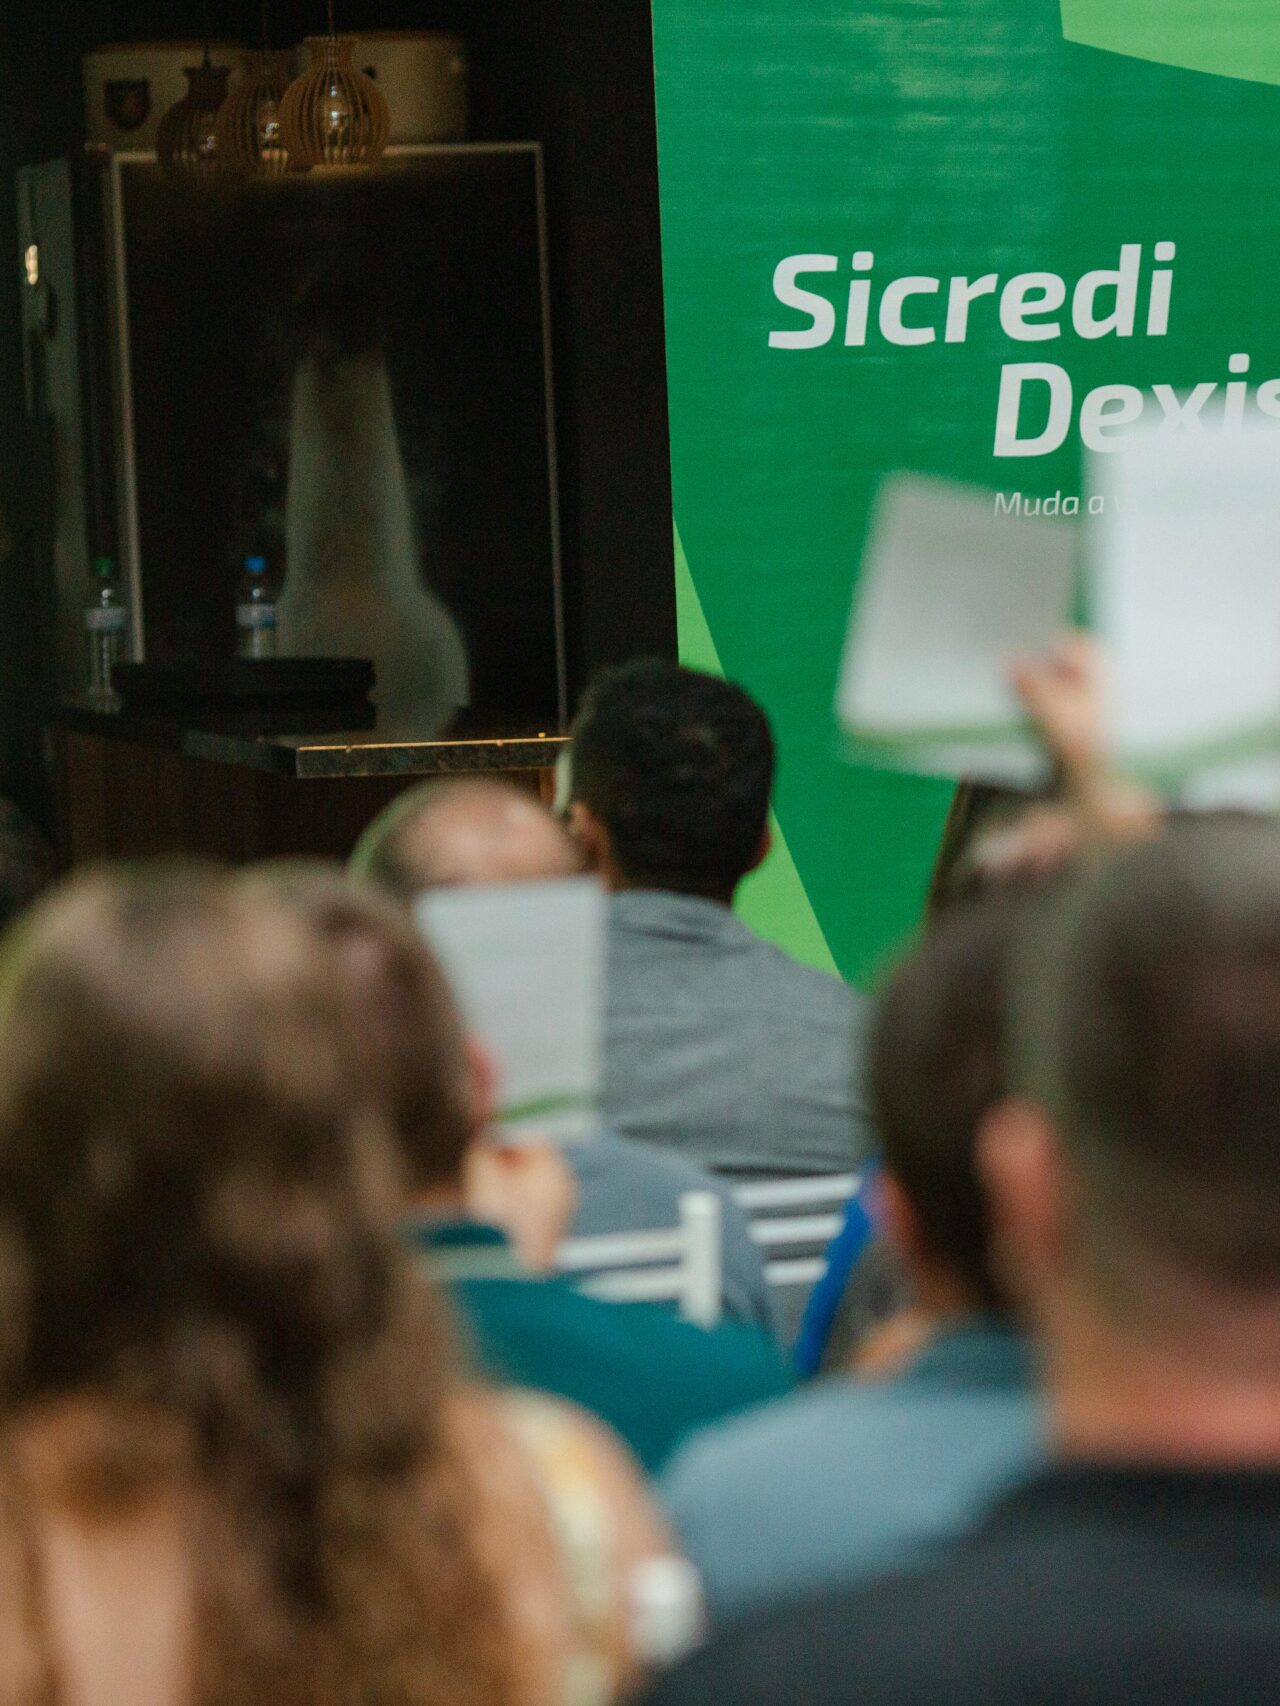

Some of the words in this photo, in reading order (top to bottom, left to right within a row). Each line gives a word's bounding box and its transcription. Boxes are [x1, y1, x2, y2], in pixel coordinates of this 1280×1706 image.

[768, 241, 1176, 349] Sicredi
[994, 490, 1080, 517] Muda
[1088, 495, 1105, 515] a
